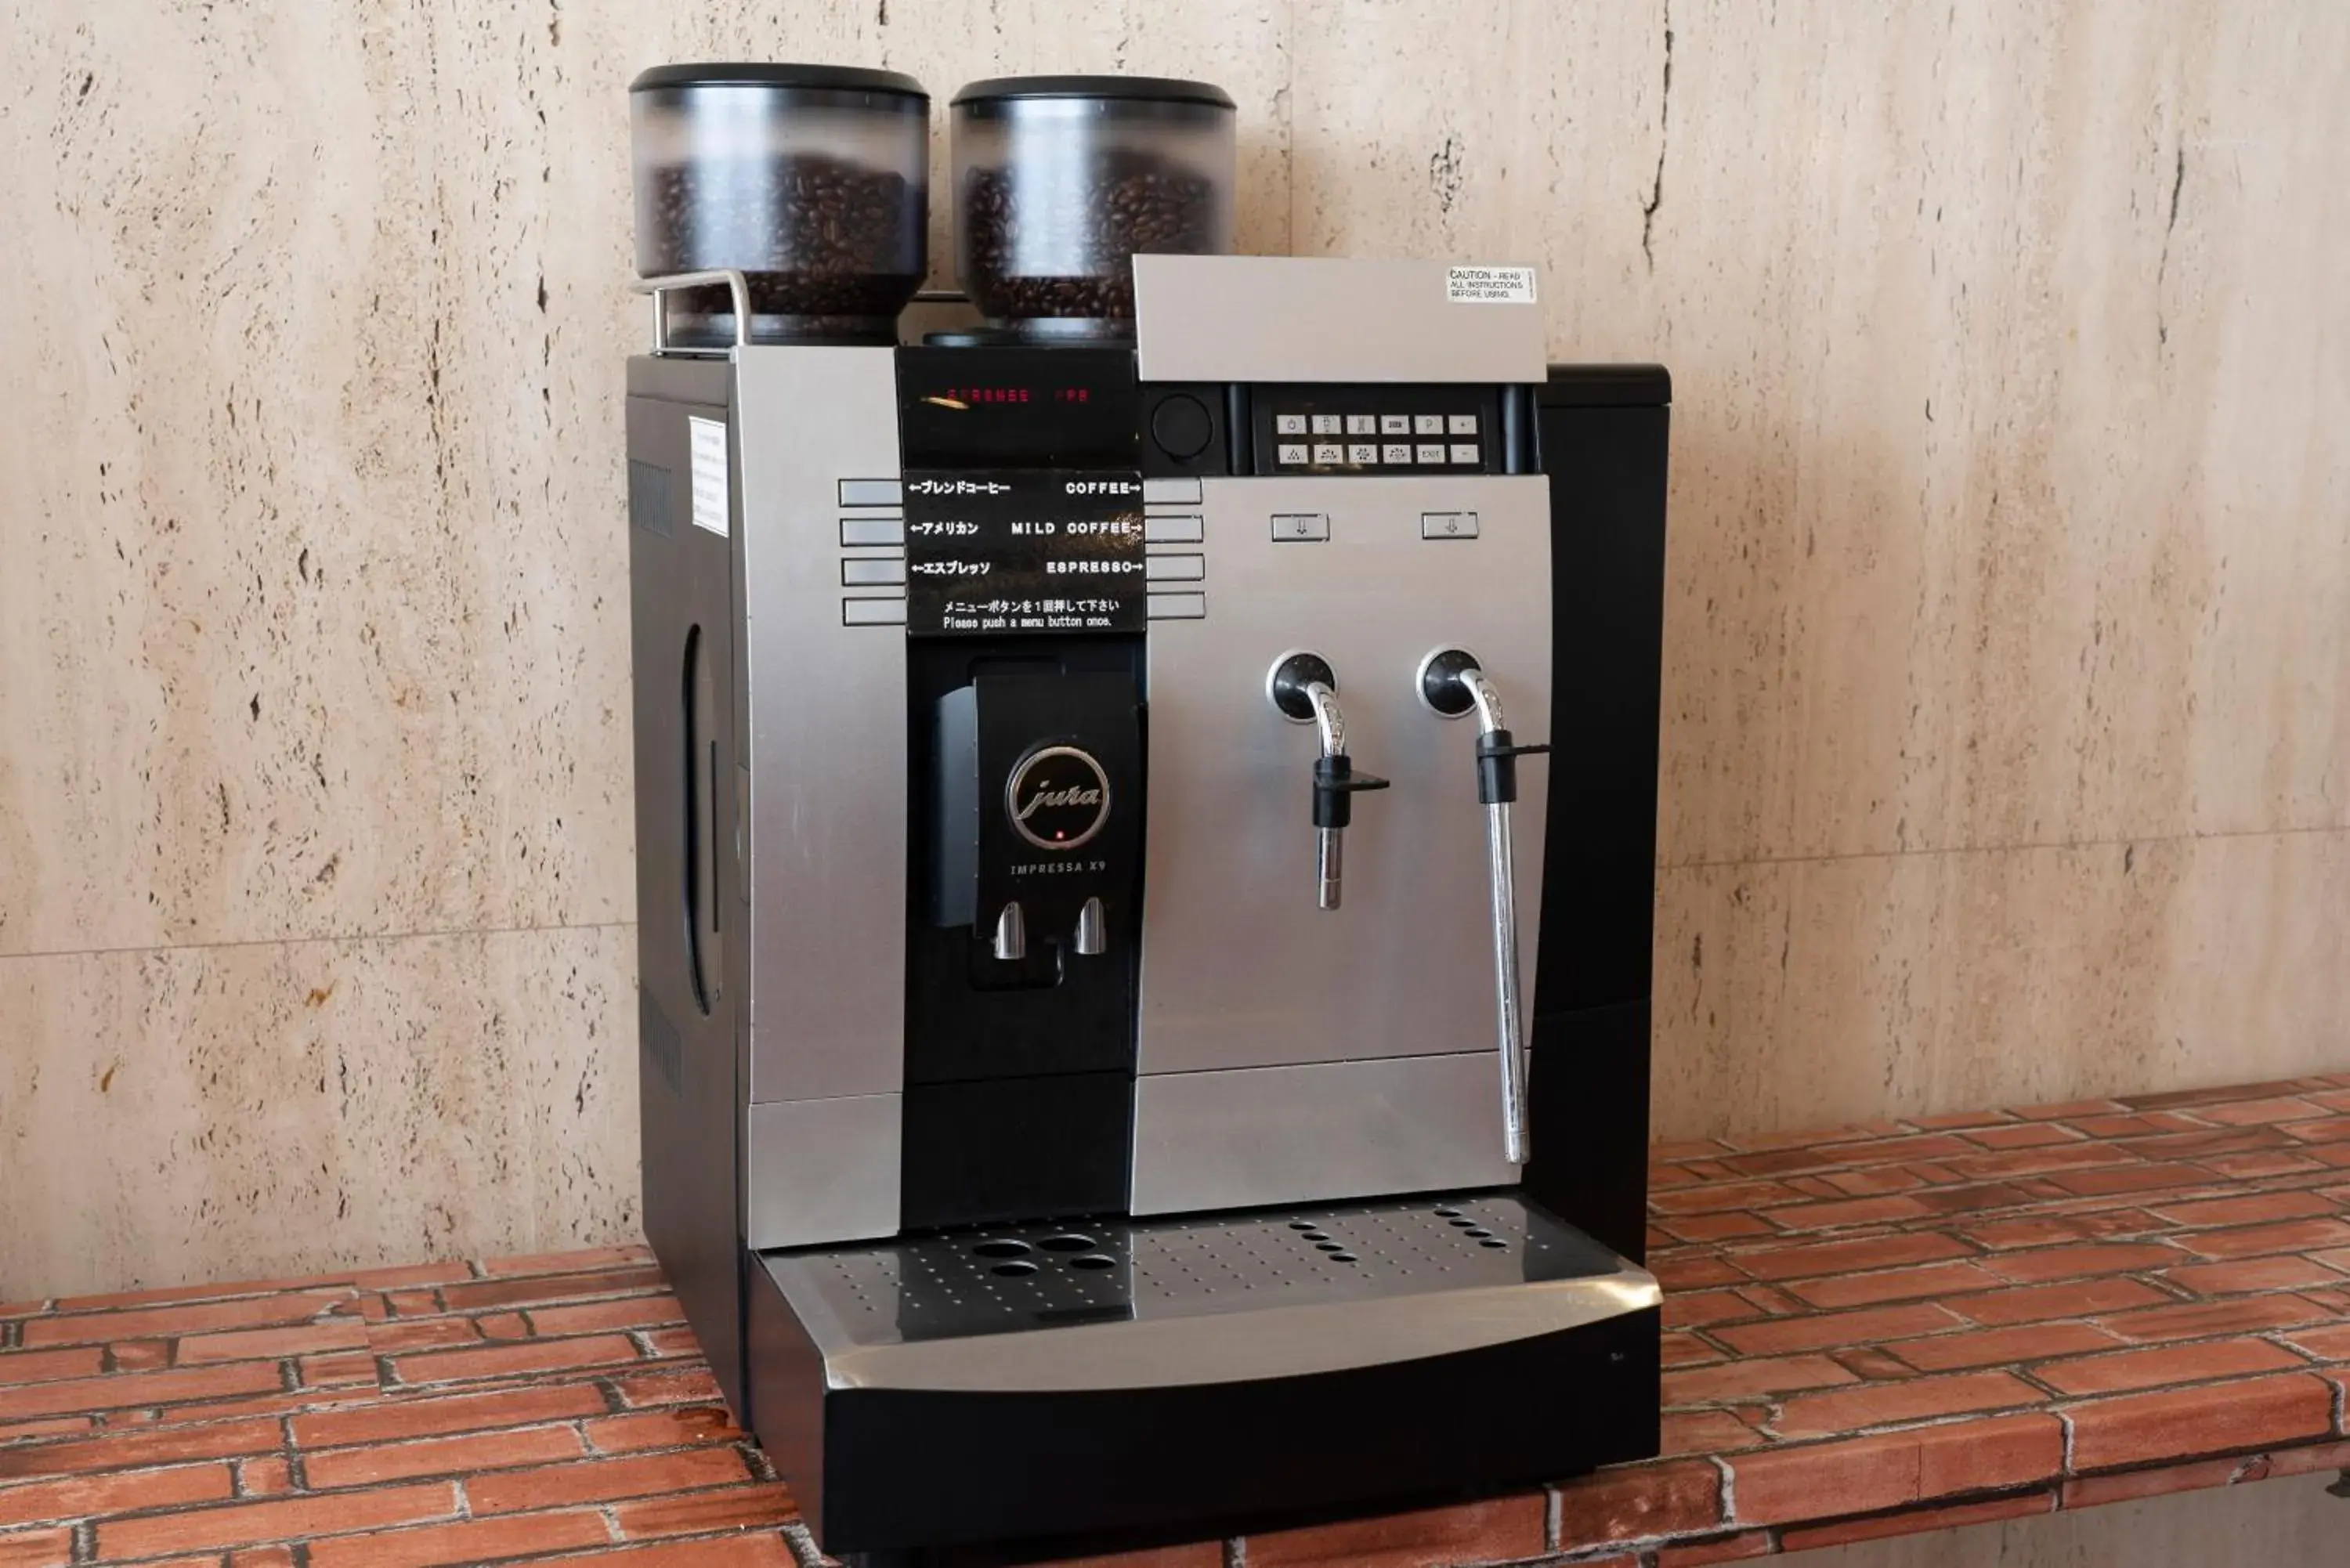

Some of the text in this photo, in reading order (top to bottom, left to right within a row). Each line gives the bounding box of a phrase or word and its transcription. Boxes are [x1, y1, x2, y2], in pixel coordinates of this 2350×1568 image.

[1449, 269, 1491, 280] CAUTION
[1499, 272, 1521, 280] READ
[1451, 289, 1482, 298] BEFORE
[1422, 450, 1440, 459] EXIT
[920, 479, 1011, 494] ブレンドコーヒー
[1065, 482, 1130, 494] COFFEE
[922, 521, 978, 535] アメリカン
[1011, 522, 1130, 535] MILD COFFEE
[923, 560, 990, 575] エスプレッソ
[1046, 562, 1133, 573] ESPRESSO
[943, 616, 978, 629] Please
[982, 616, 1007, 629] push
[1021, 618, 1044, 627] menu
[1048, 616, 1082, 627] button
[1086, 617, 1112, 627] once.
[1016, 779, 1101, 820] jura
[1010, 862, 1083, 876] IMPRESSA
